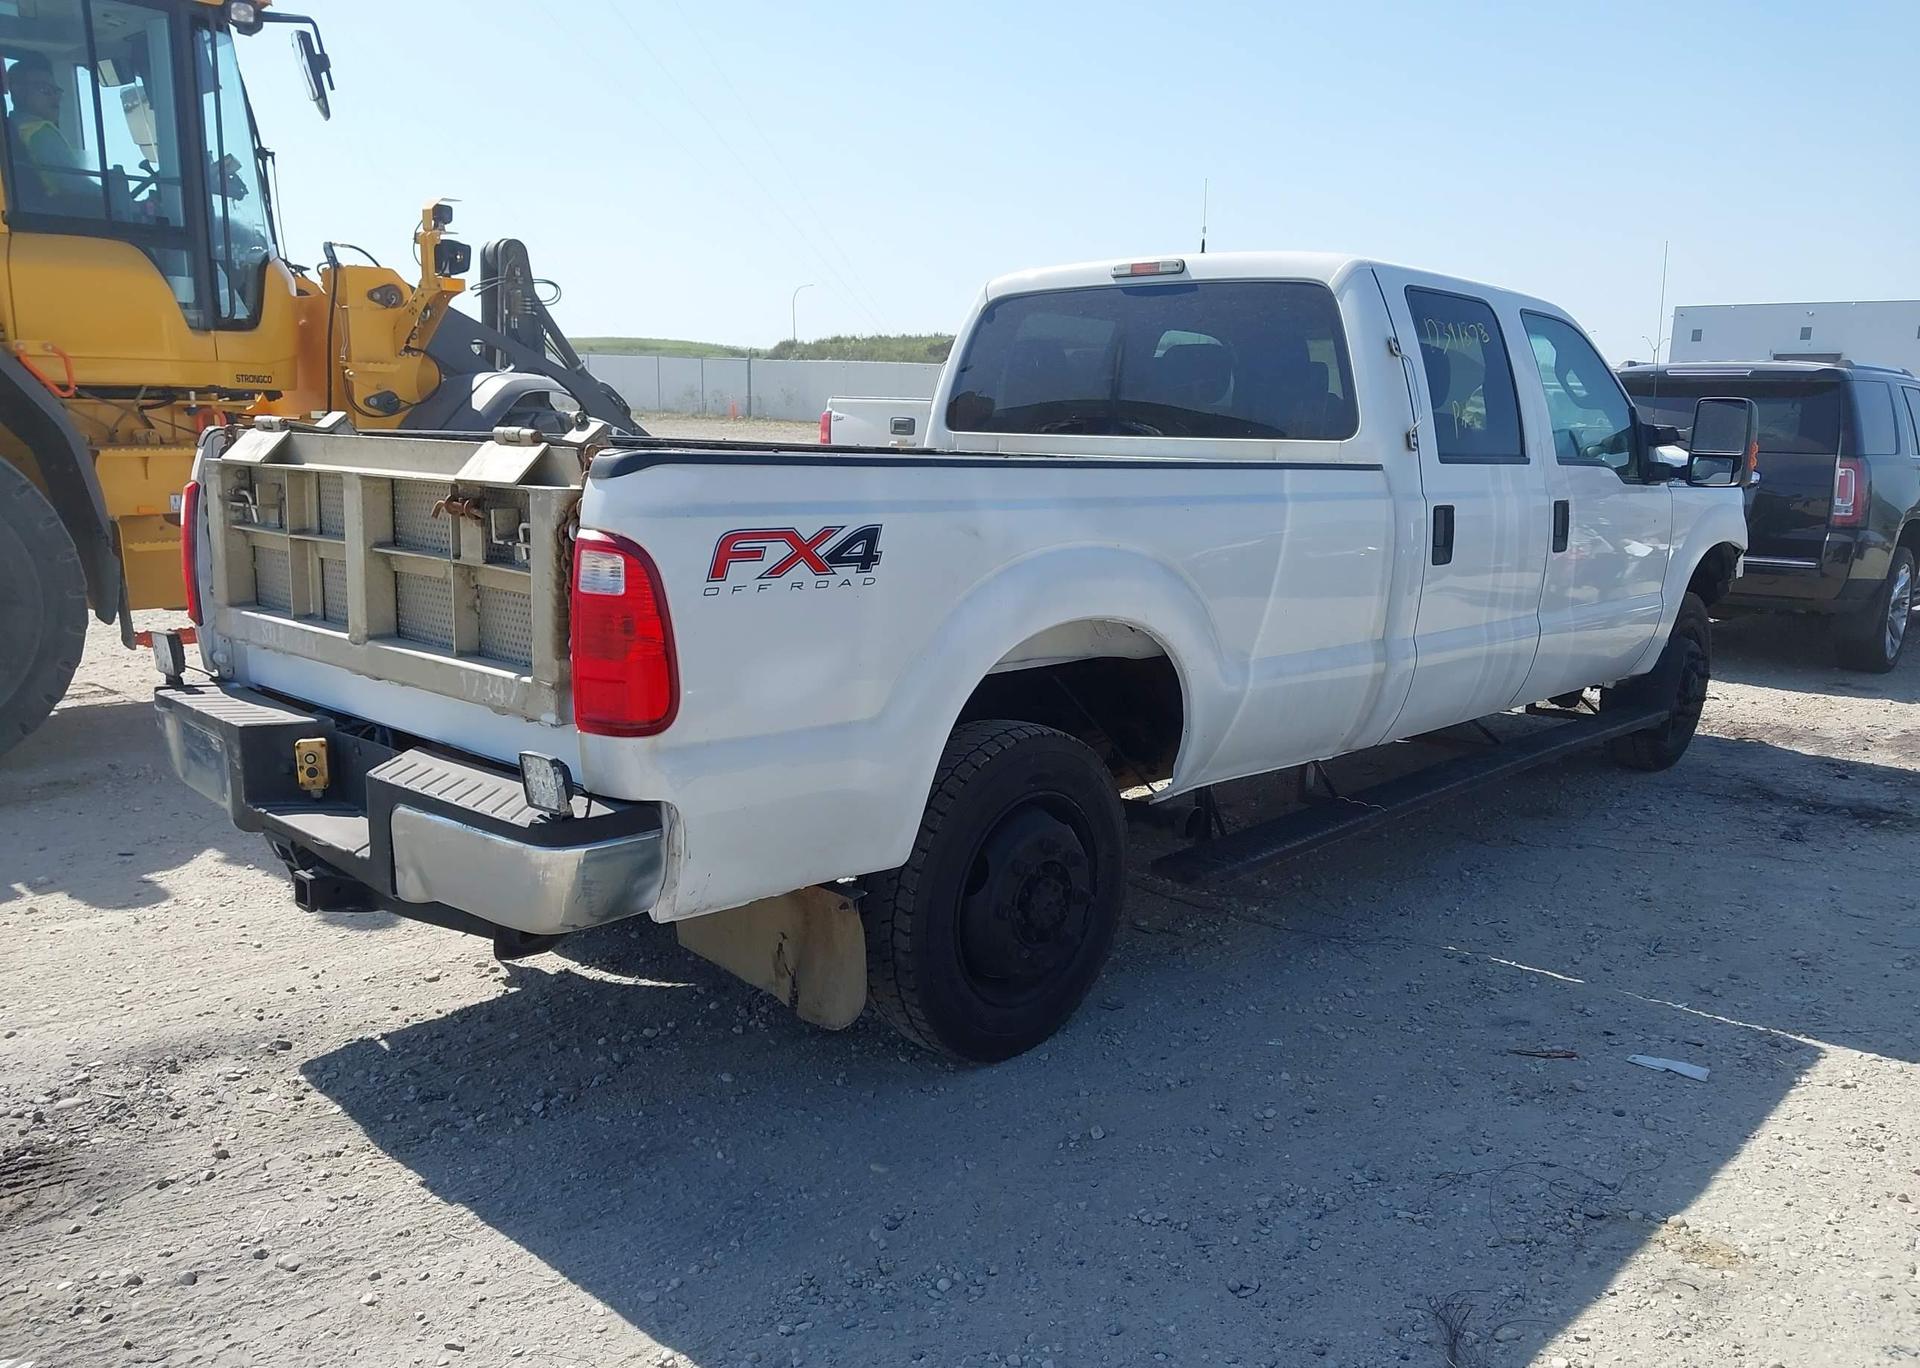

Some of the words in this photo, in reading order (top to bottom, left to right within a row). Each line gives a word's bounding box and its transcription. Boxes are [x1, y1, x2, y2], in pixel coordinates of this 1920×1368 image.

[235, 374, 273, 384] STRONGCO
[706, 523, 883, 583] FX4
[703, 583, 772, 597] OFF
[790, 577, 876, 591] ROAD
